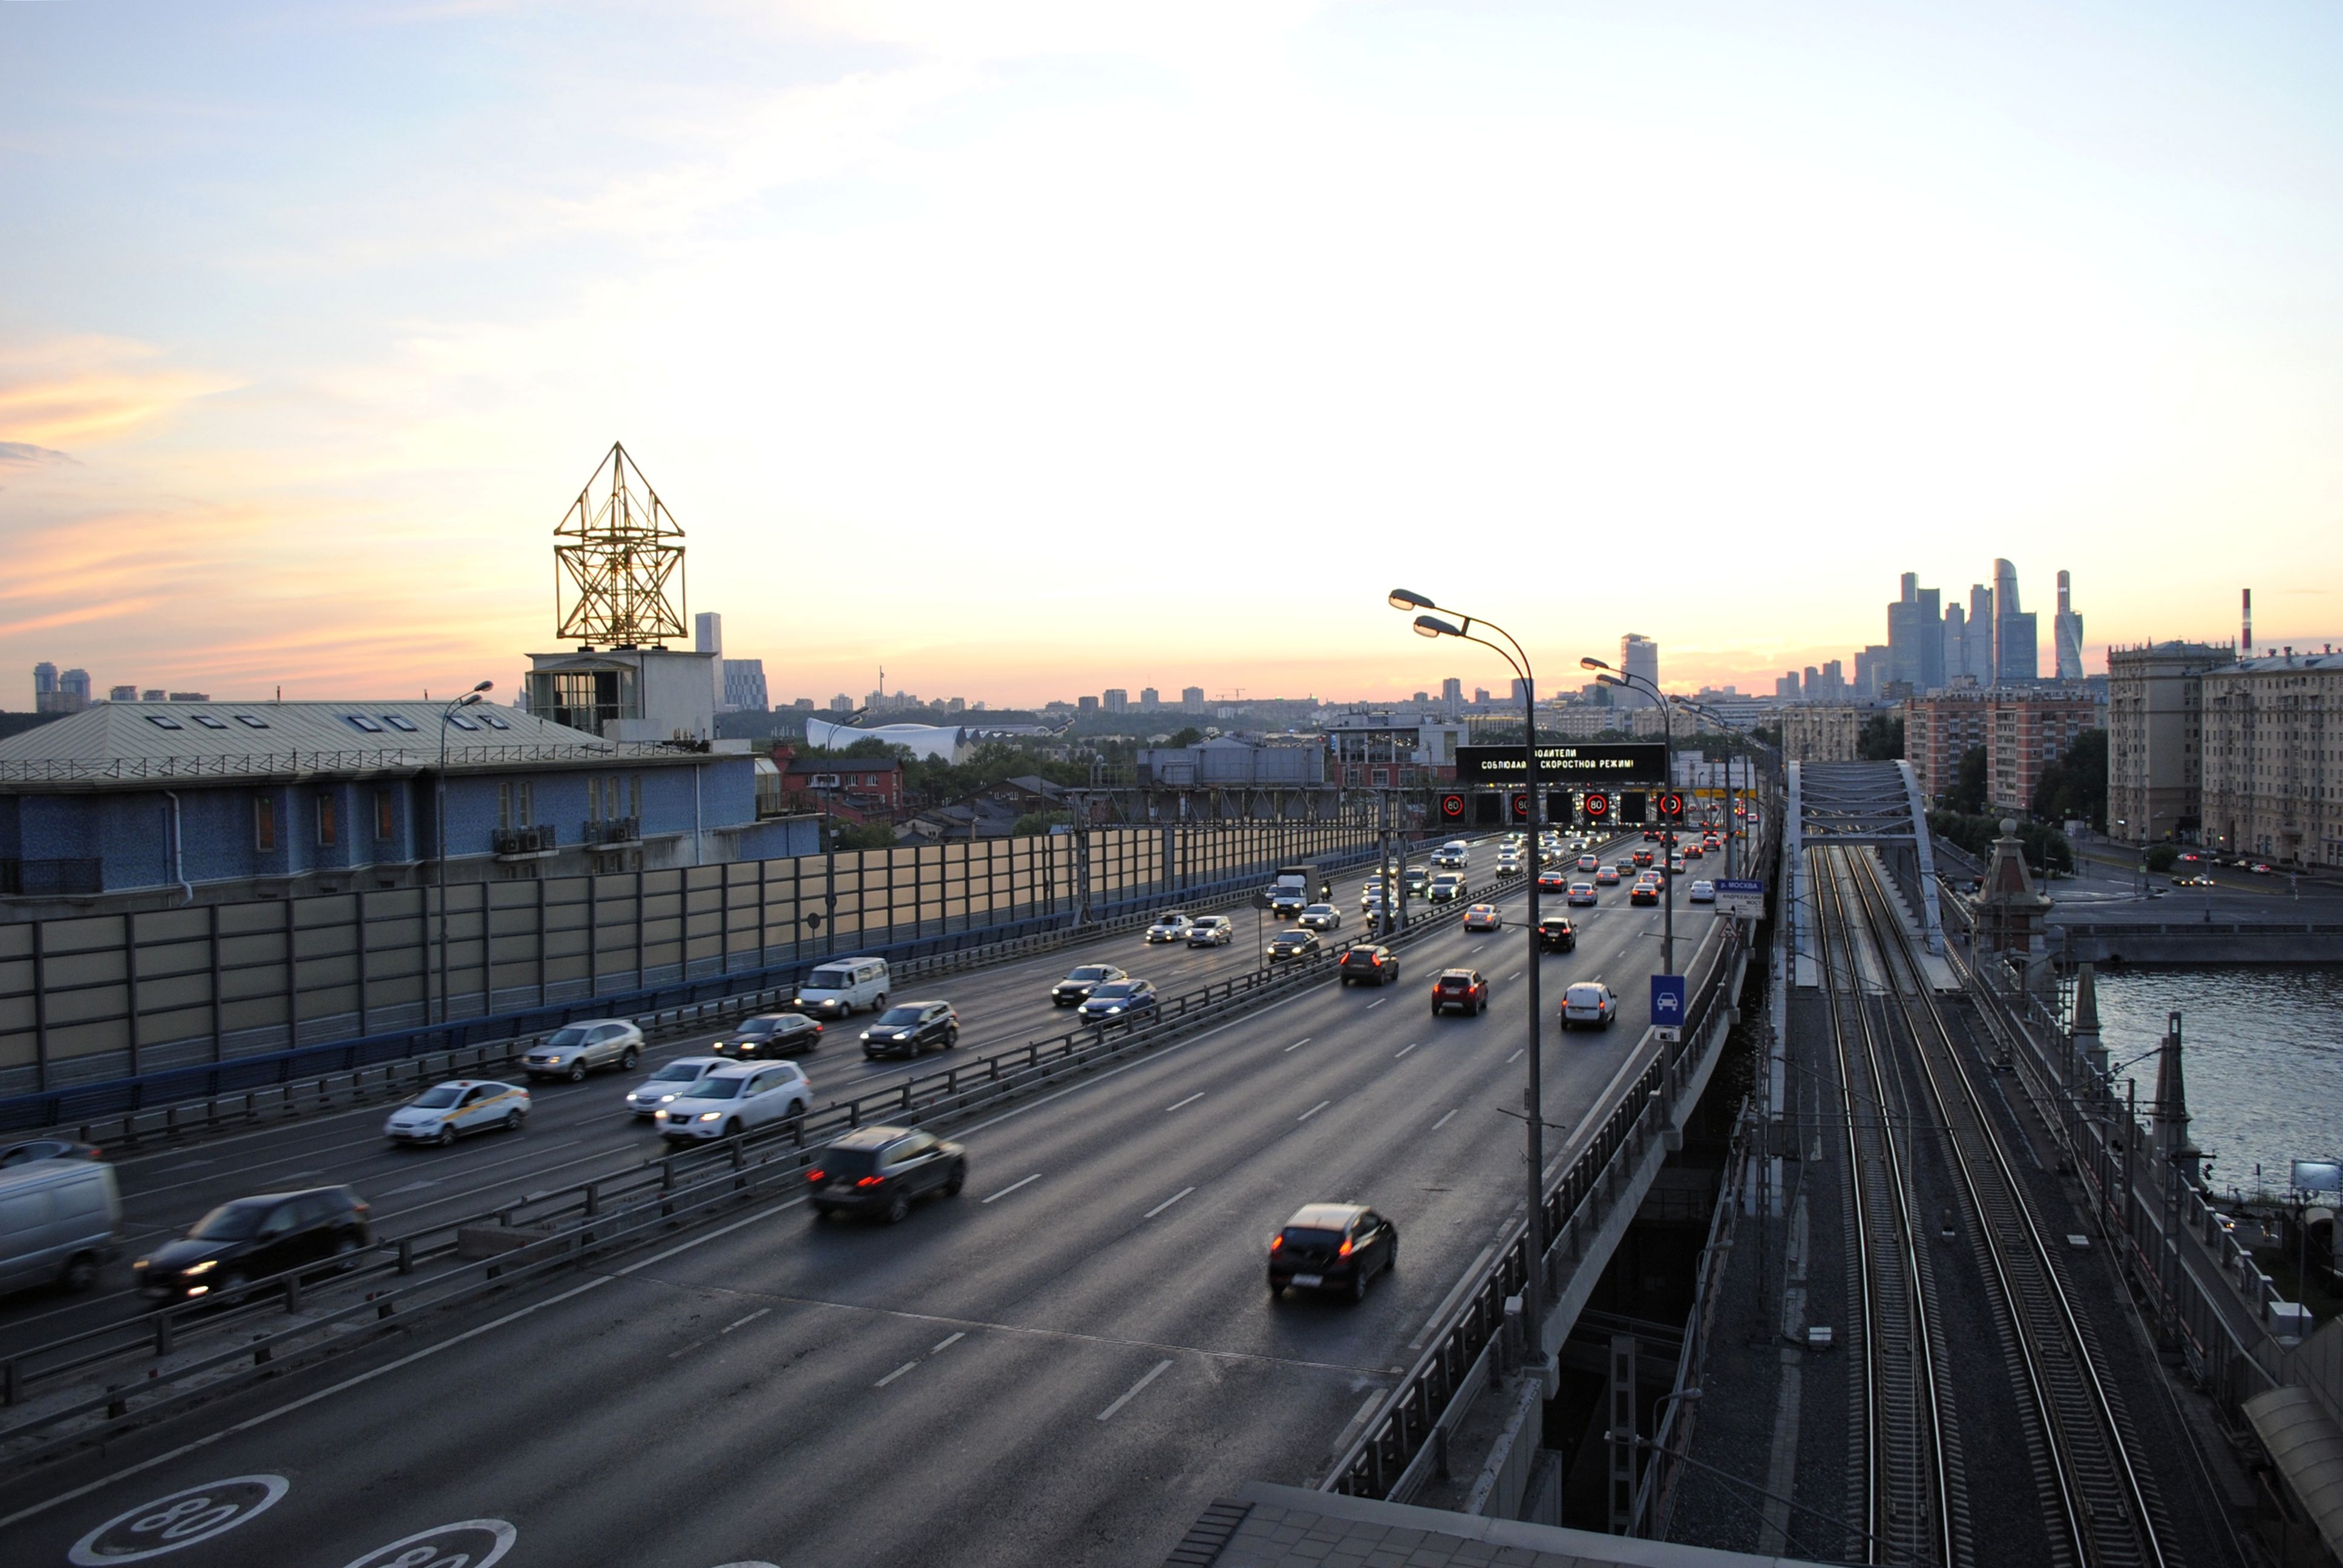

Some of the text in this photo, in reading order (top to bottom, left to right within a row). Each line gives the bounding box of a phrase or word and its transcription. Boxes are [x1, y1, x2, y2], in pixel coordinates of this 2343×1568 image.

[1540, 760, 1596, 768] СКОРОСТНОЙ
[1447, 801, 1459, 809] 80
[1590, 800, 1602, 809] 80
[130, 1497, 240, 1538] 80
